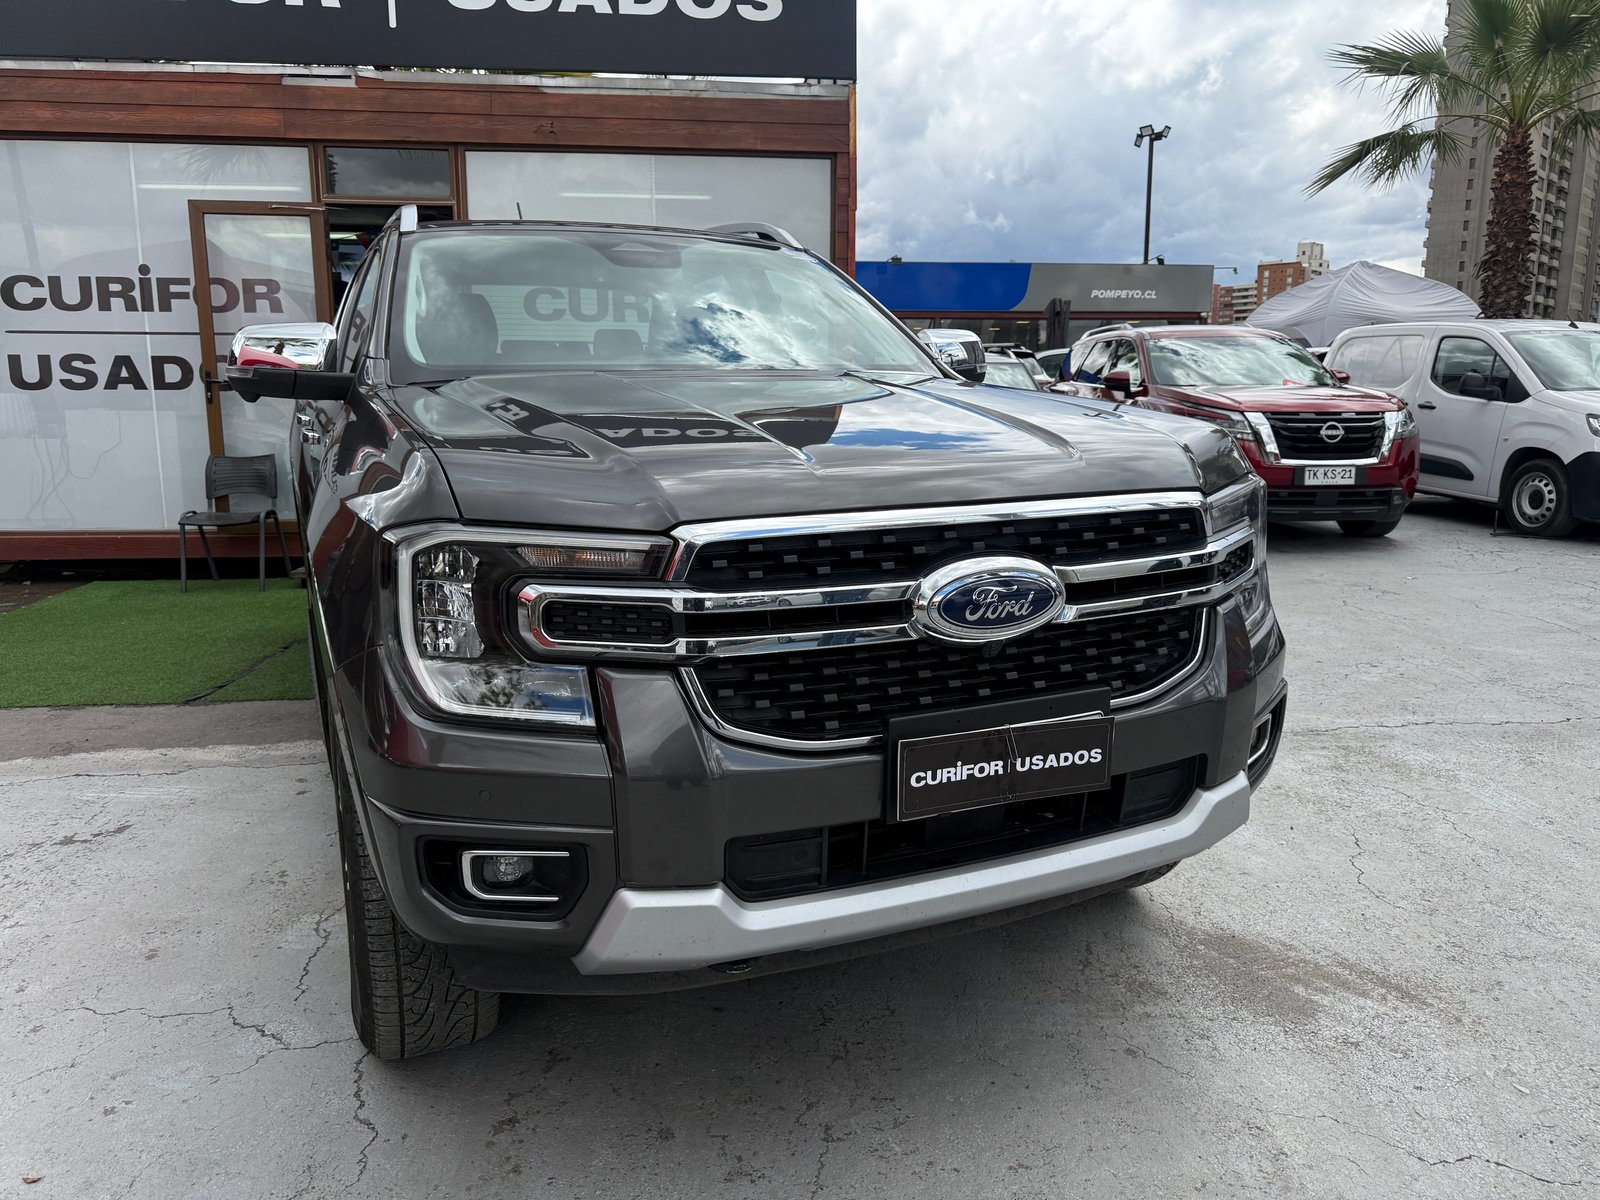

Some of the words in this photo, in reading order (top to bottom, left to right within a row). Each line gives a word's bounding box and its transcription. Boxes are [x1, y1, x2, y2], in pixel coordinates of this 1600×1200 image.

[1090, 289, 1157, 299] POMPEYO.CL
[7, 353, 228, 391] USAD
[965, 585, 1035, 622] Ford
[1015, 748, 1102, 772] USADOS
